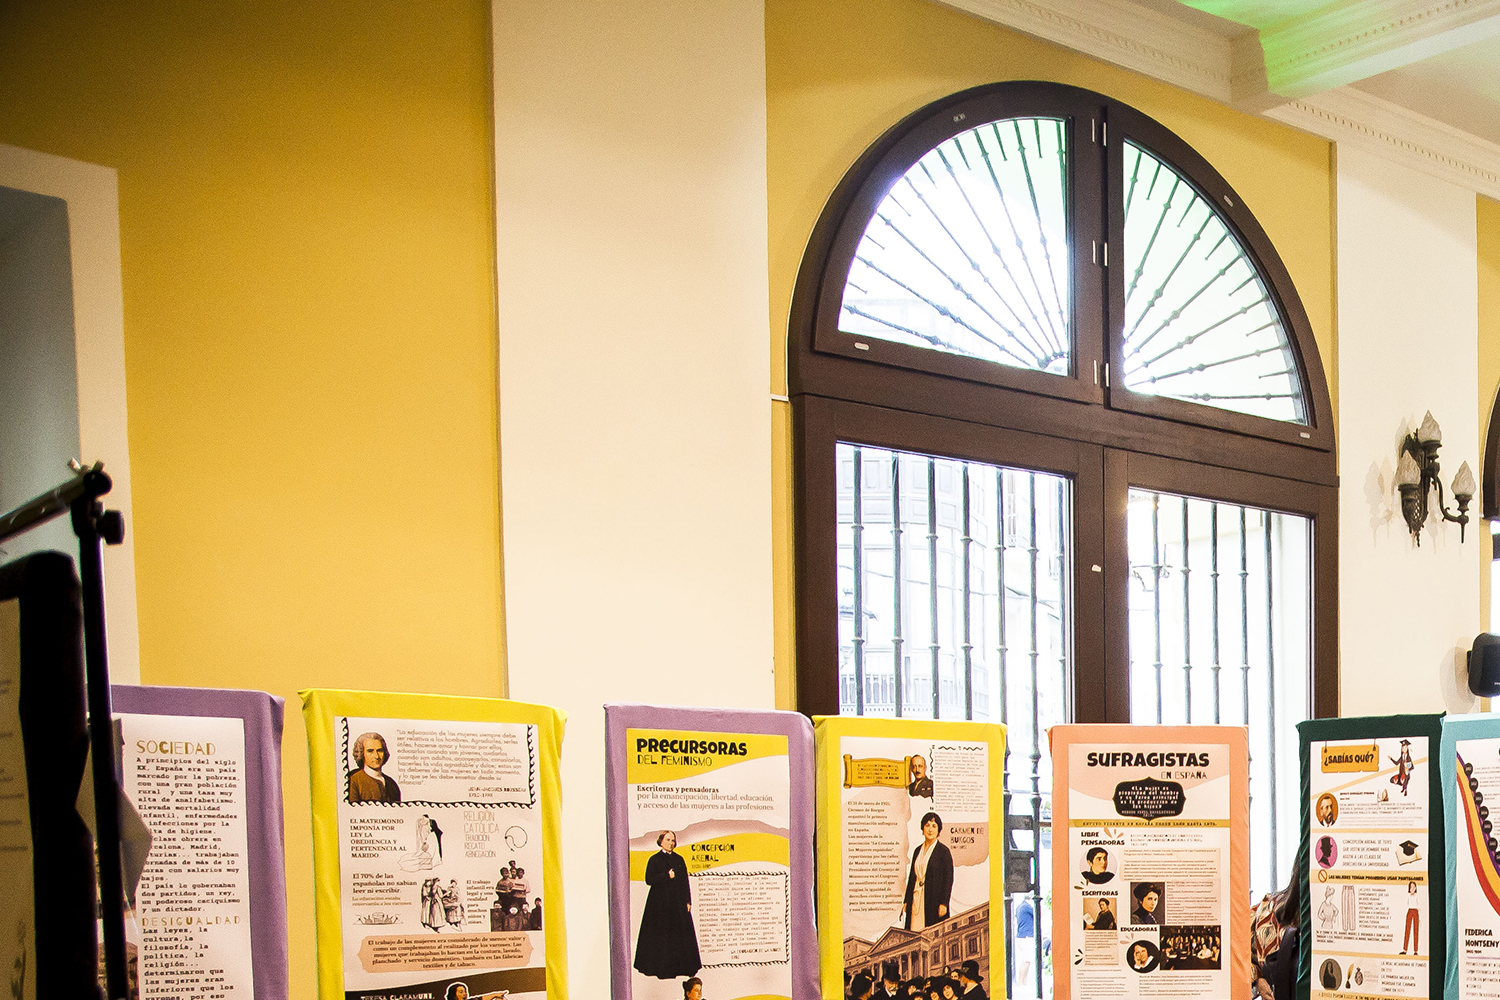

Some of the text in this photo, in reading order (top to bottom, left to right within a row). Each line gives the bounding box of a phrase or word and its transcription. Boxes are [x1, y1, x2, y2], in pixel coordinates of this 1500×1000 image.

[136, 740, 216, 756] SOCIEDAD
[637, 754, 712, 767] DEL FEMINISMO
[1087, 752, 1209, 767] SUFRAGISTAS
[1324, 753, 1354, 767] ¿SABÍAS
[1175, 770, 1207, 779] ESPAÑA
[142, 916, 241, 926] DESIGUALDAD
[1465, 928, 1493, 937] FEDERICA
[1465, 939, 1500, 948] MONTSENY
